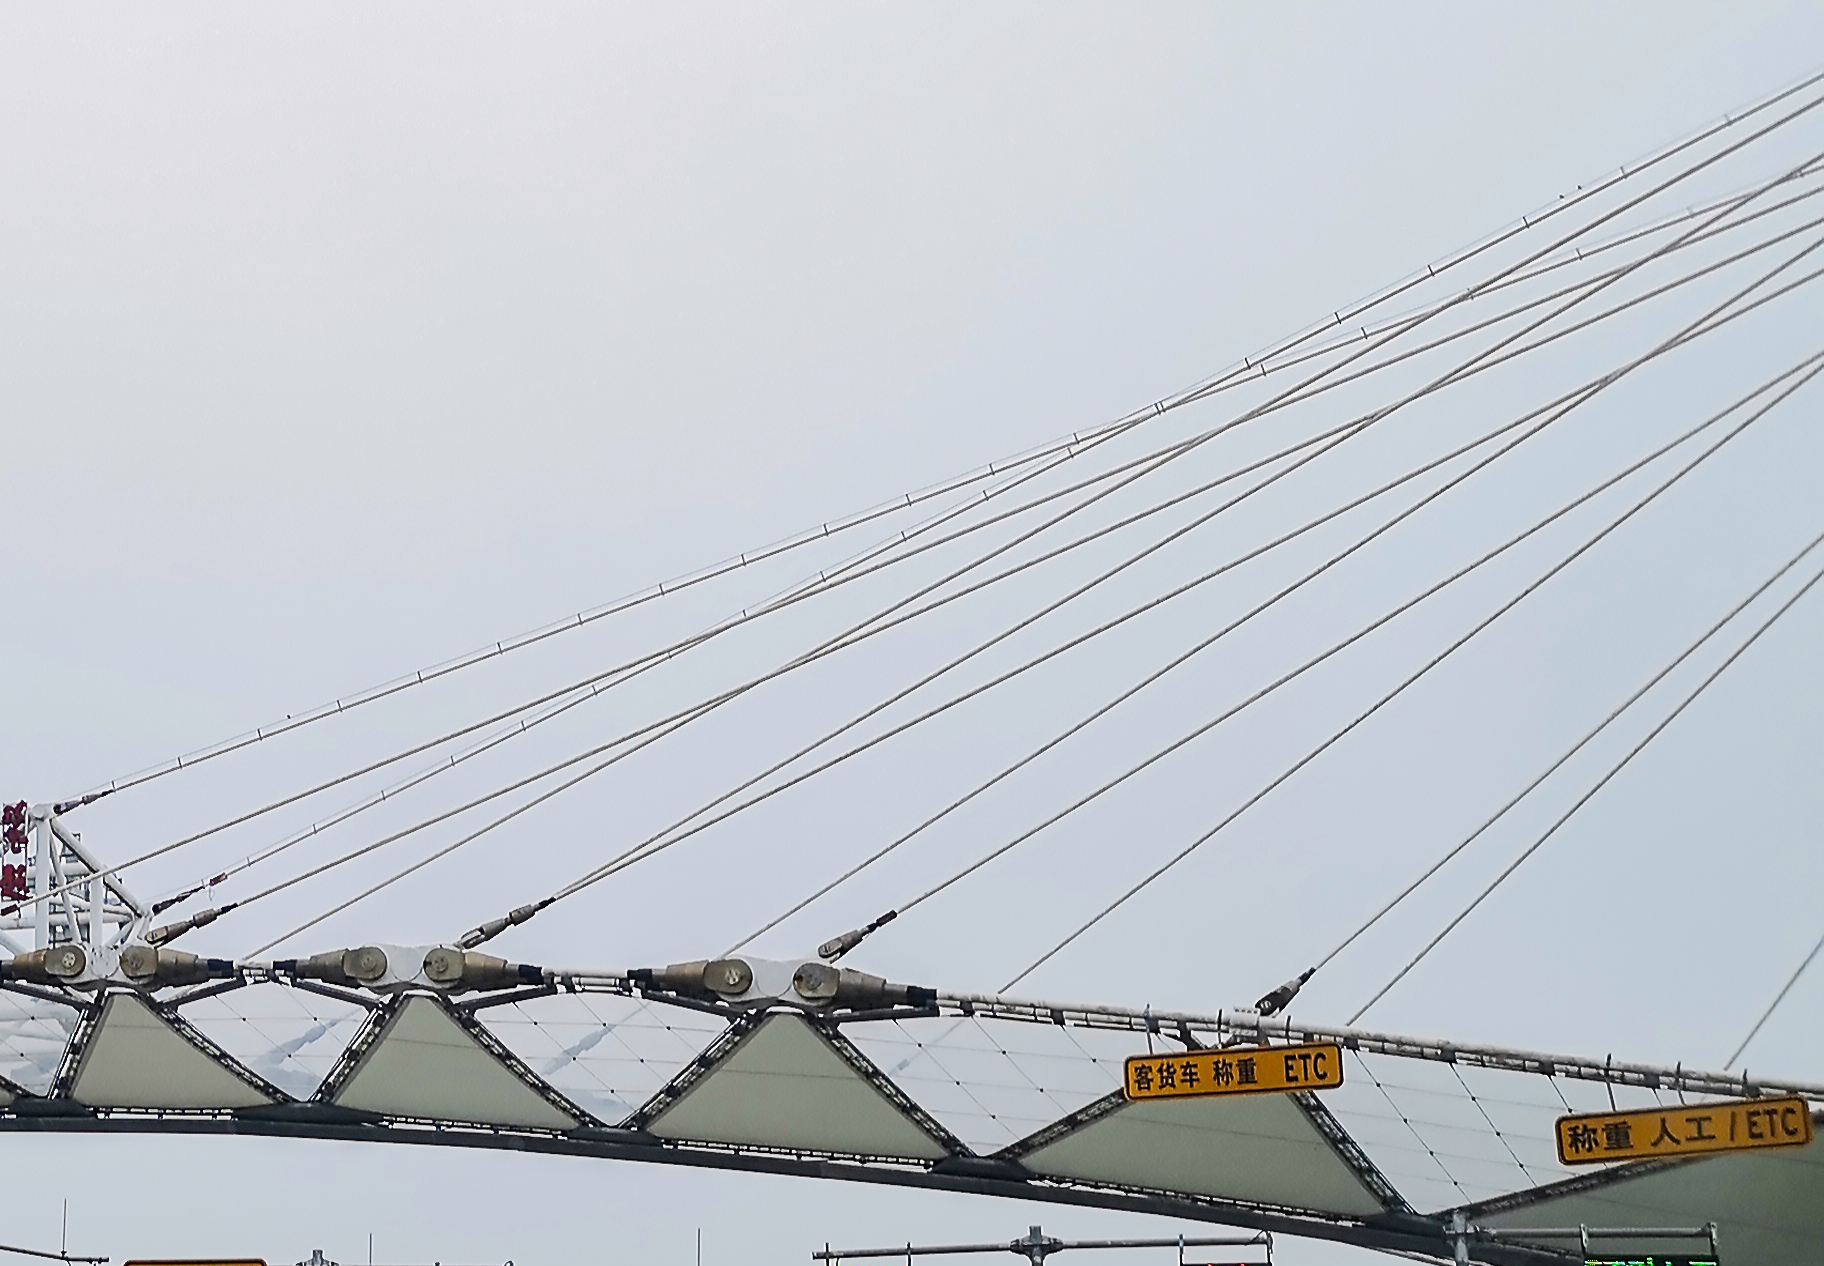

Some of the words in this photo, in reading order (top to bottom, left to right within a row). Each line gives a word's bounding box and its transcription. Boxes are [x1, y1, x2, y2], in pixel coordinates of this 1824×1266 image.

[1133, 1061, 1200, 1091] 客货车
[1212, 1057, 1258, 1087] 称重
[1283, 1052, 1328, 1083] ETC
[1567, 1120, 1634, 1154] 称重
